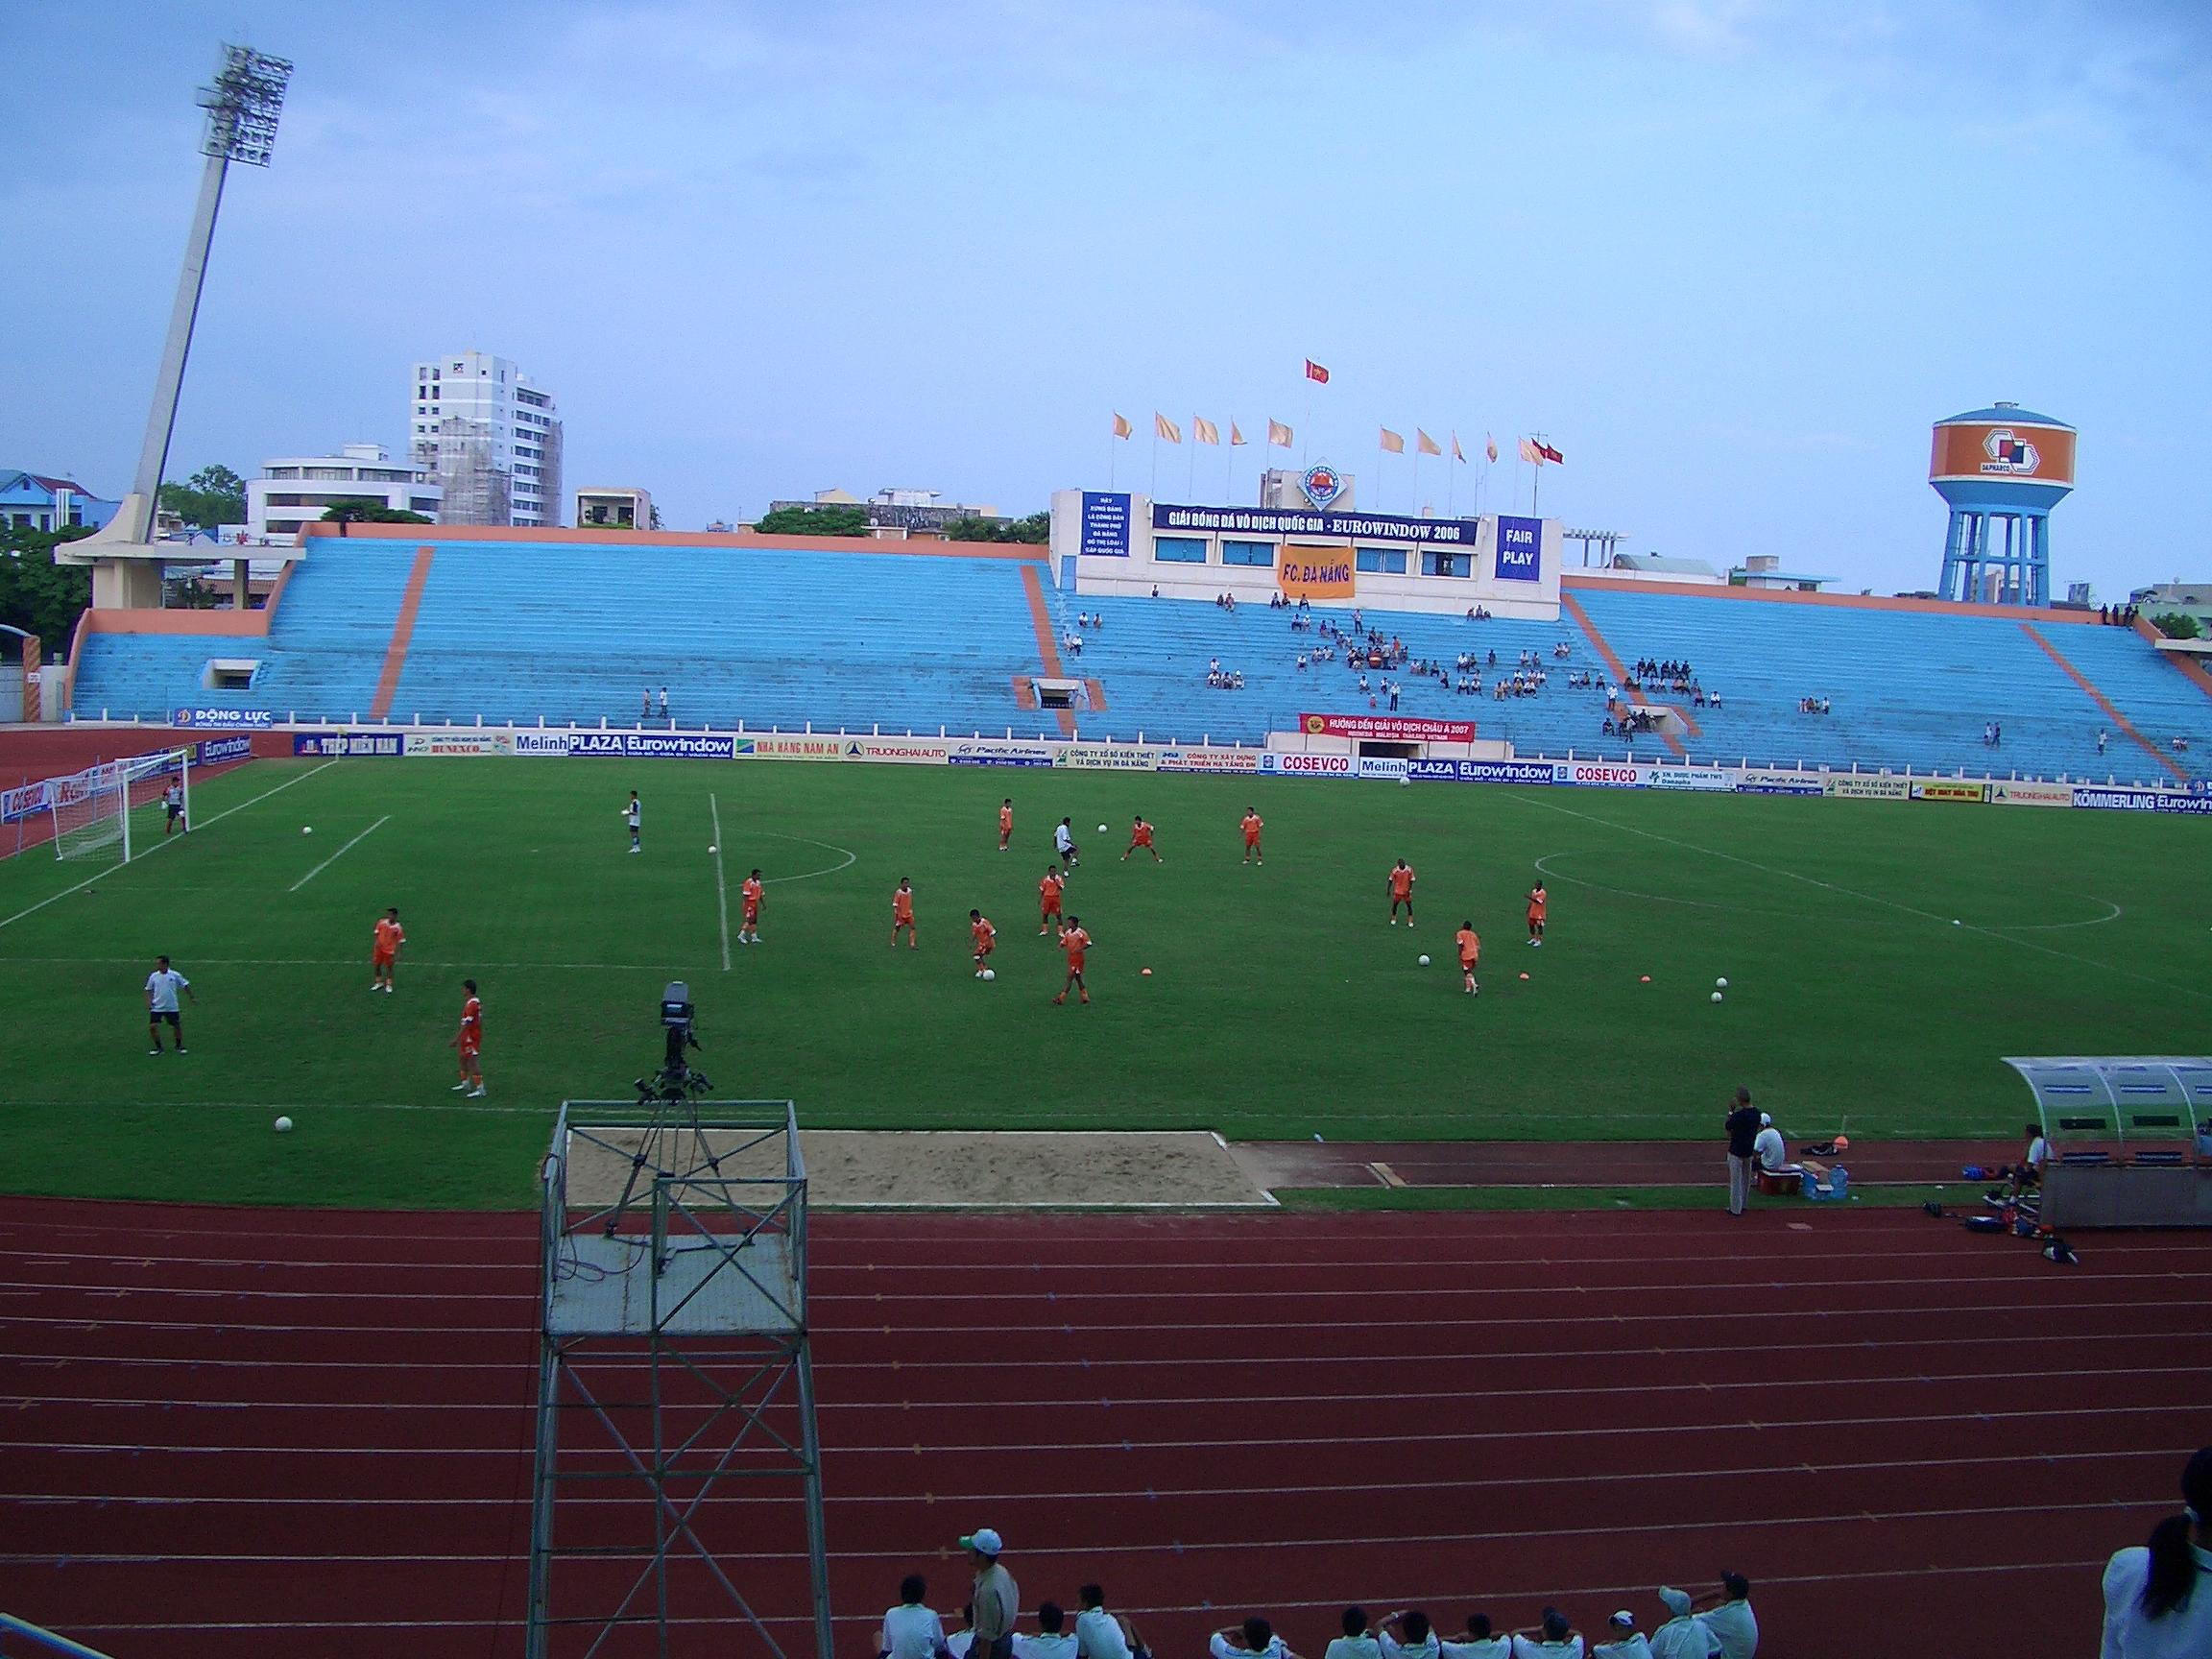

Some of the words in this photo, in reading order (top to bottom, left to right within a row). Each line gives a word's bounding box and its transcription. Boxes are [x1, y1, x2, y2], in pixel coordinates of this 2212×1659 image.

[1192, 511, 1219, 528] BÓNG
[1221, 513, 1235, 528] ĐÁ
[1277, 515, 1306, 532] QUỐC
[1306, 517, 1324, 532] GIA
[1332, 518, 1431, 540] EUROWINDOW
[1433, 526, 1460, 541] 2006
[1505, 529, 1533, 543] FAIR
[1503, 551, 1534, 565] PLAY
[1283, 564, 1301, 582] FC.
[196, 709, 241, 722] ĐỘNG
[517, 735, 568, 751] Melinh
[569, 735, 622, 751] PLAZA
[627, 735, 732, 753] Eurowindow
[1283, 756, 1349, 772] COSEVCO
[1362, 760, 1407, 774] Melinh
[1408, 761, 1454, 774] PLAZA
[1459, 762, 1551, 779] Eurowindow
[1575, 767, 1637, 781] COSEVCO
[2074, 790, 2154, 808] KÖMMERLING
